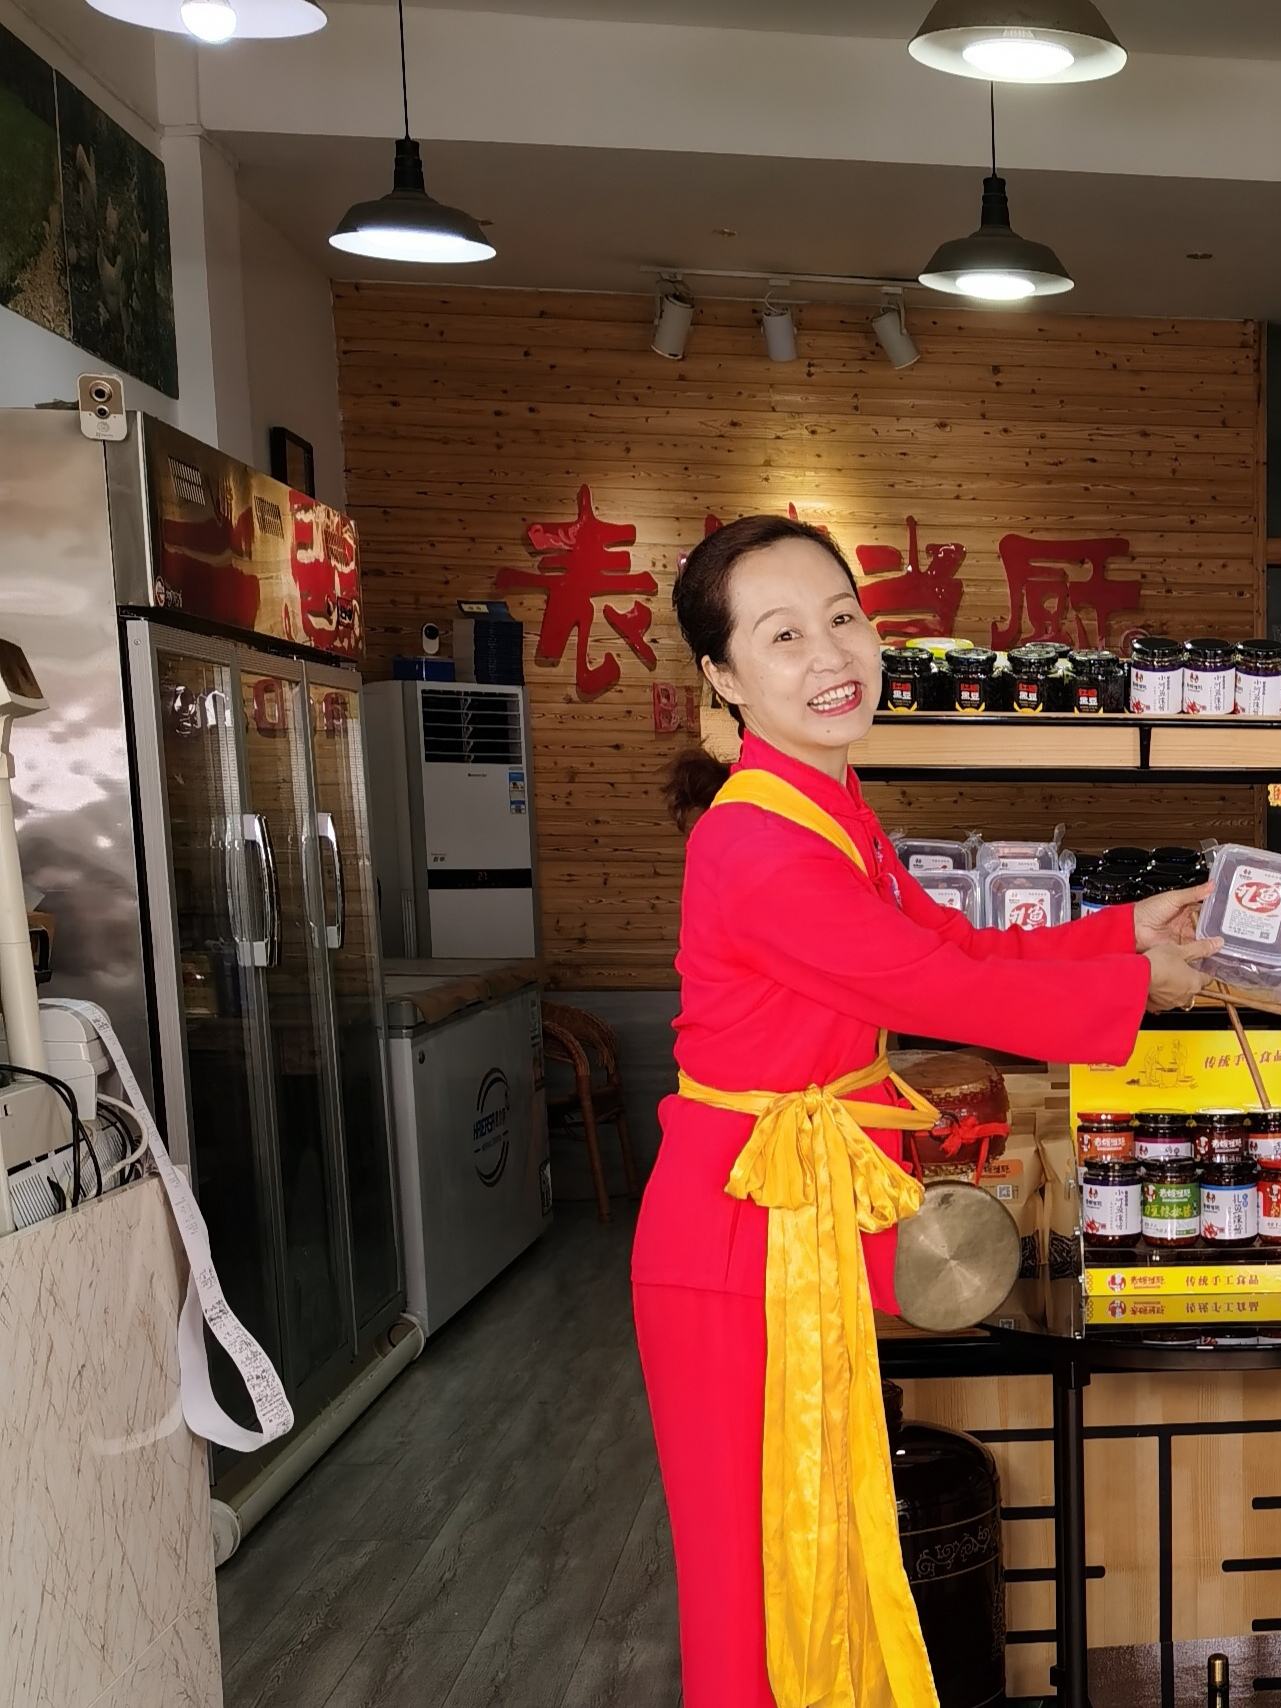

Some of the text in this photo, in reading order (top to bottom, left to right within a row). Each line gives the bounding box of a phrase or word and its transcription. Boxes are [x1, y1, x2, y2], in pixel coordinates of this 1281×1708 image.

[499, 483, 1143, 697] 表当厨
[1186, 1274, 1258, 1287] 传统手工食品
